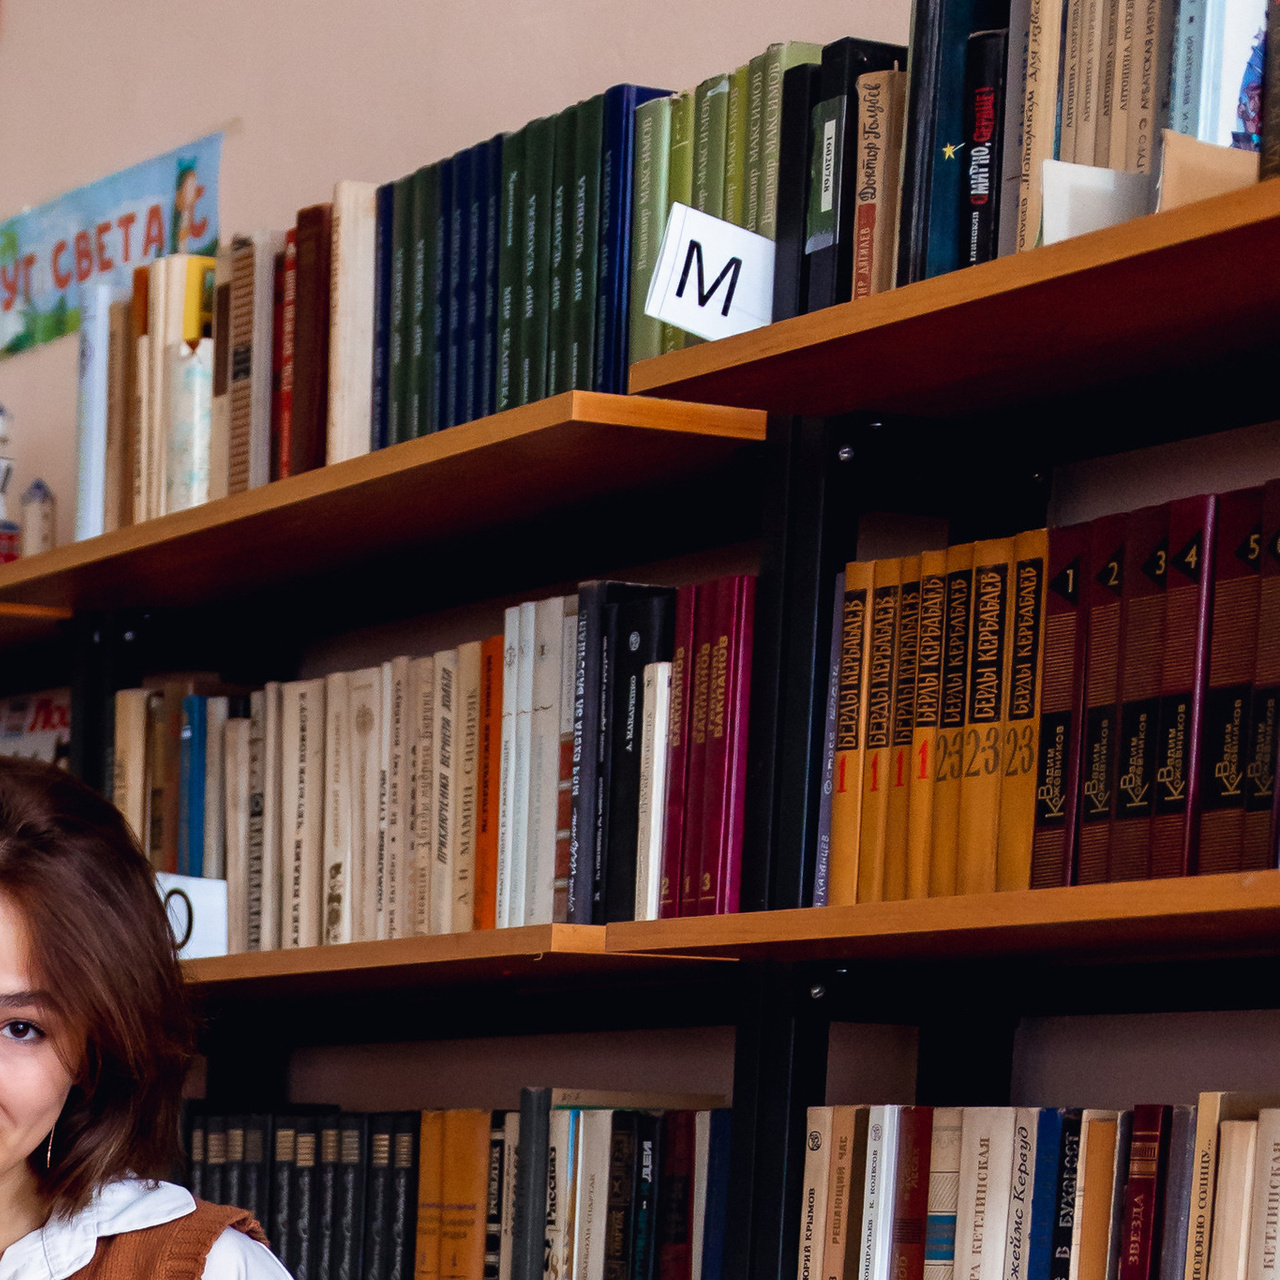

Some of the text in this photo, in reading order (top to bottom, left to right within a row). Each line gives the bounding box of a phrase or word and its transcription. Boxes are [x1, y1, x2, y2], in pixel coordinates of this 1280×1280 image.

[766, 62, 780, 154] МАКСИМОВ
[1066, 65, 1076, 128] АНТОНИНА
[1120, 46, 1132, 111] АНТОНИНА
[1141, 38, 1153, 110] АРБАТСКАЯ
[749, 72, 762, 161] МАКСИМОВ
[859, 83, 884, 202] Доктор Голубев
[640, 116, 653, 204] МАКСИМОВ
[970, 142, 992, 204] СМИРНО,
[51, 204, 166, 289] СВЕТА
[675, 238, 742, 317] М
[858, 227, 871, 274] ДЯГИЛЕВ
[1066, 569, 1074, 593] 1
[1107, 562, 1119, 585] 2
[1155, 551, 1167, 575] 3
[1184, 545, 1198, 568] 4
[1247, 534, 1260, 559] 5
[838, 600, 864, 748] БЕРДЫ КЕРБАБАЕВ
[869, 597, 896, 745] БЕРДЫ КЕРБАБАЕВ
[896, 593, 920, 743] БЕРДЫ КЕРБАБАЕВ
[916, 578, 944, 721] БЕРДЫ КЕРБАБАЕВ
[943, 579, 969, 723] БЕРДЫ КЕРБАБАЕВ
[973, 572, 1002, 718] БЕРДЫ КЕРБАБАЕВ
[1012, 567, 1037, 715] БЕРДЫ КЕРБАБАЕВ
[627, 675, 637, 738] МАКАРЕНКО
[672, 647, 685, 746] БАКЛАНОВ
[696, 642, 711, 743] БАКЛАНОВ
[714, 635, 728, 738] БАКЛАНОВ
[437, 667, 453, 864] ПРИКЛЮЧЕНИЯ ВЕРНЕРА ХОЛЬТА
[460, 688, 478, 856] МАМИН СИБИРЯК
[836, 754, 847, 793] 1
[869, 753, 879, 792] 1
[895, 748, 904, 787] 1
[917, 740, 929, 779] 1
[1038, 748, 1055, 799] Вадим
[1045, 725, 1065, 817] Кожевников
[1084, 743, 1100, 795] Вадим
[1090, 719, 1110, 812] Кожевников
[1120, 737, 1138, 789] Вадим
[1126, 713, 1149, 807] Кожевников
[1157, 728, 1176, 782] Вадим
[1164, 704, 1186, 800] Кожевников
[1215, 723, 1233, 777] Вадим
[1221, 699, 1242, 795] Кожевников
[702, 872, 711, 891] 3
[831, 1135, 848, 1245] РЕШАЮЩИЙ ЧАС
[869, 1149, 878, 1195] КОЛЕСОВ
[971, 1137, 990, 1255] КЕТЛИНСКАЯ
[1012, 1126, 1030, 1203] Кервуд
[1196, 1139, 1212, 1210] СОЛНЦУ...
[802, 1187, 815, 1280] ЮРИЙ КРЫМОВ
[868, 1200, 874, 1209] К.
[1128, 1194, 1144, 1265] ЗВЕЗДА
[1055, 1245, 1070, 1258] В
[1192, 1214, 1207, 1280] ПОДОБНО
